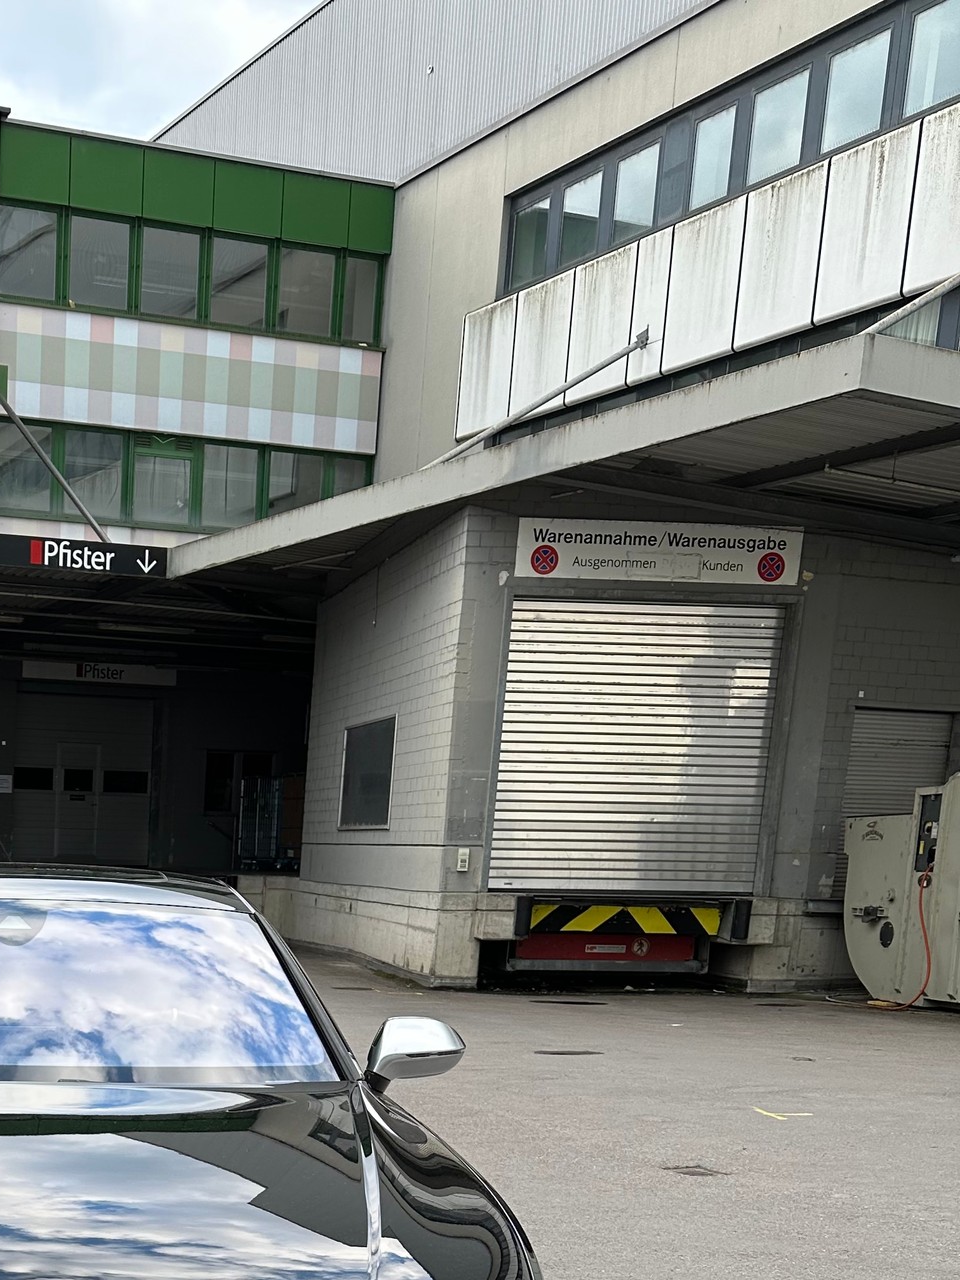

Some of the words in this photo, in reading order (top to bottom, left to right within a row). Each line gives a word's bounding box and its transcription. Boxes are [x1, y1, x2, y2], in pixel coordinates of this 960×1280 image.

[44, 540, 115, 571] Pfister
[572, 556, 657, 570] Ausgenommen
[702, 559, 744, 573] Kunden
[83, 663, 125, 680] Pfister
